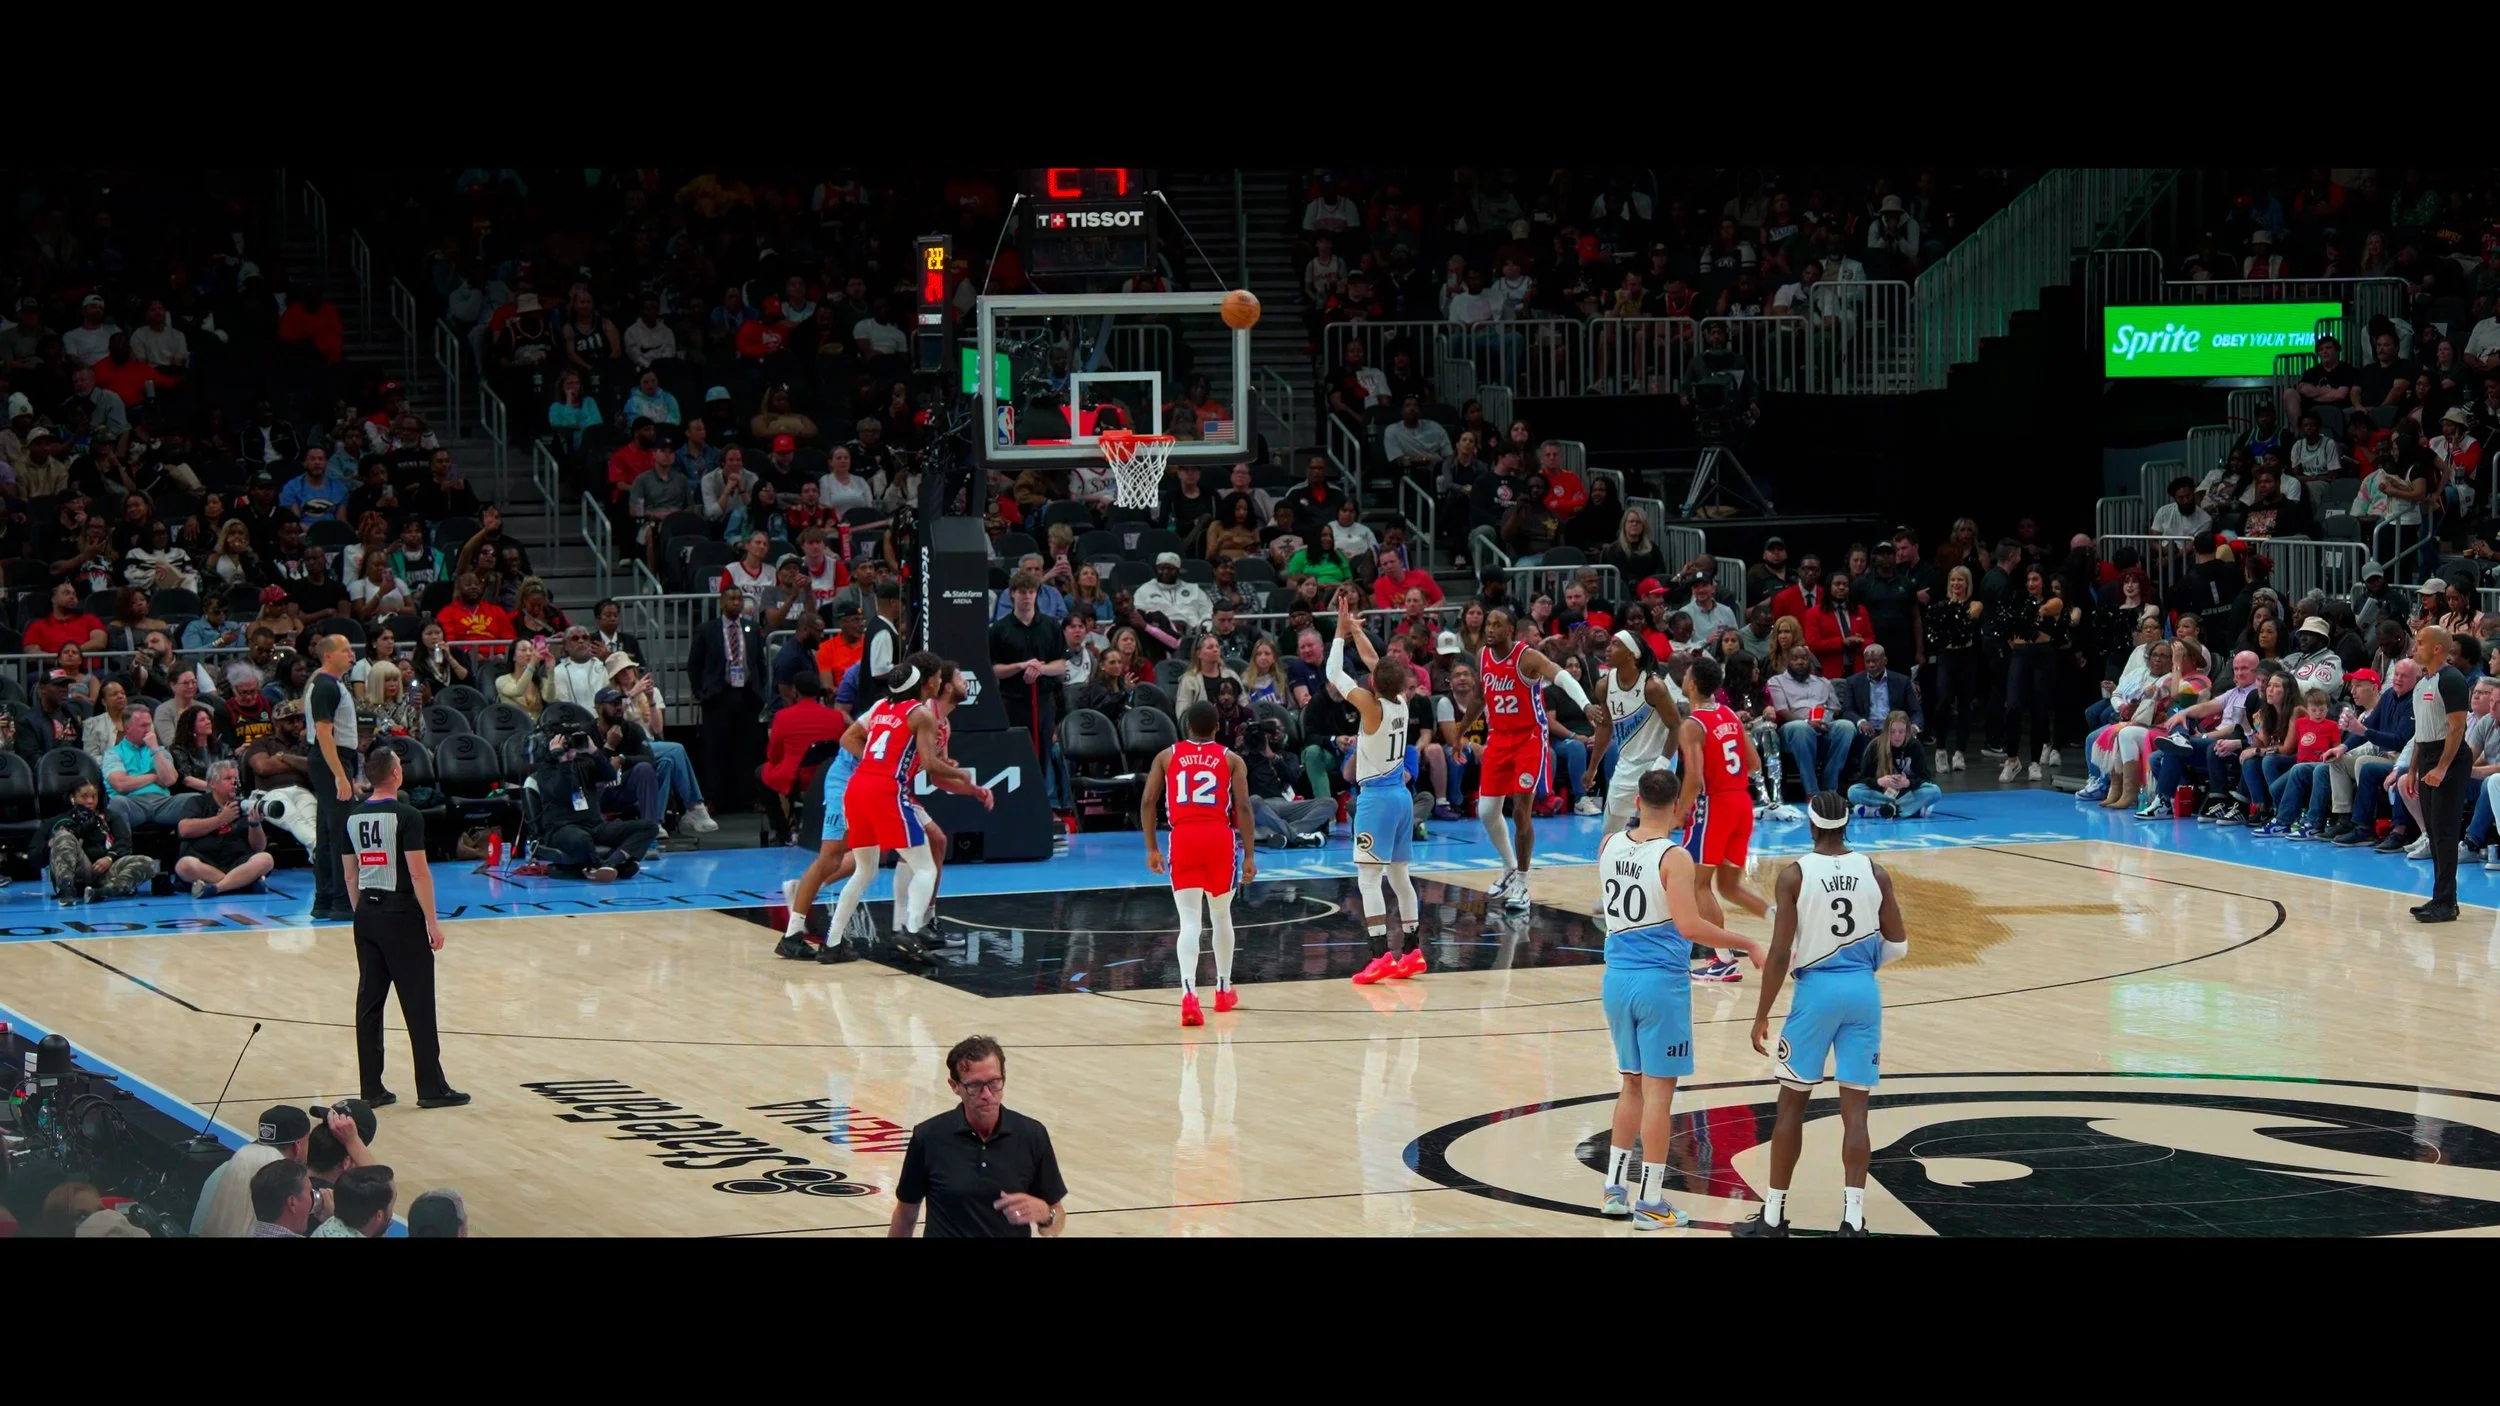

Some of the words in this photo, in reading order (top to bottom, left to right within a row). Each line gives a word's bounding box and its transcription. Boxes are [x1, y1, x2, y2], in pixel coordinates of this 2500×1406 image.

[1066, 211, 1145, 229] TISSOT
[2111, 323, 2201, 361] Sprite
[2212, 333, 2248, 348] OBEY
[2249, 332, 2286, 347] YOUR
[921, 546, 931, 652] ticketmas
[1483, 672, 1515, 694] Phila
[1494, 695, 1519, 714] 22
[1611, 701, 1624, 716] 14
[236, 722, 272, 737] HAWKS
[1386, 731, 1404, 762] 11
[1722, 739, 1742, 776] 5
[1179, 754, 1221, 770] BUTLER
[1176, 771, 1217, 804] 12
[359, 821, 382, 848] 64
[1615, 861, 1643, 880] NIANG
[1605, 878, 1647, 923] 20
[1831, 897, 1856, 938] 3
[1666, 1040, 1689, 1057] atl
